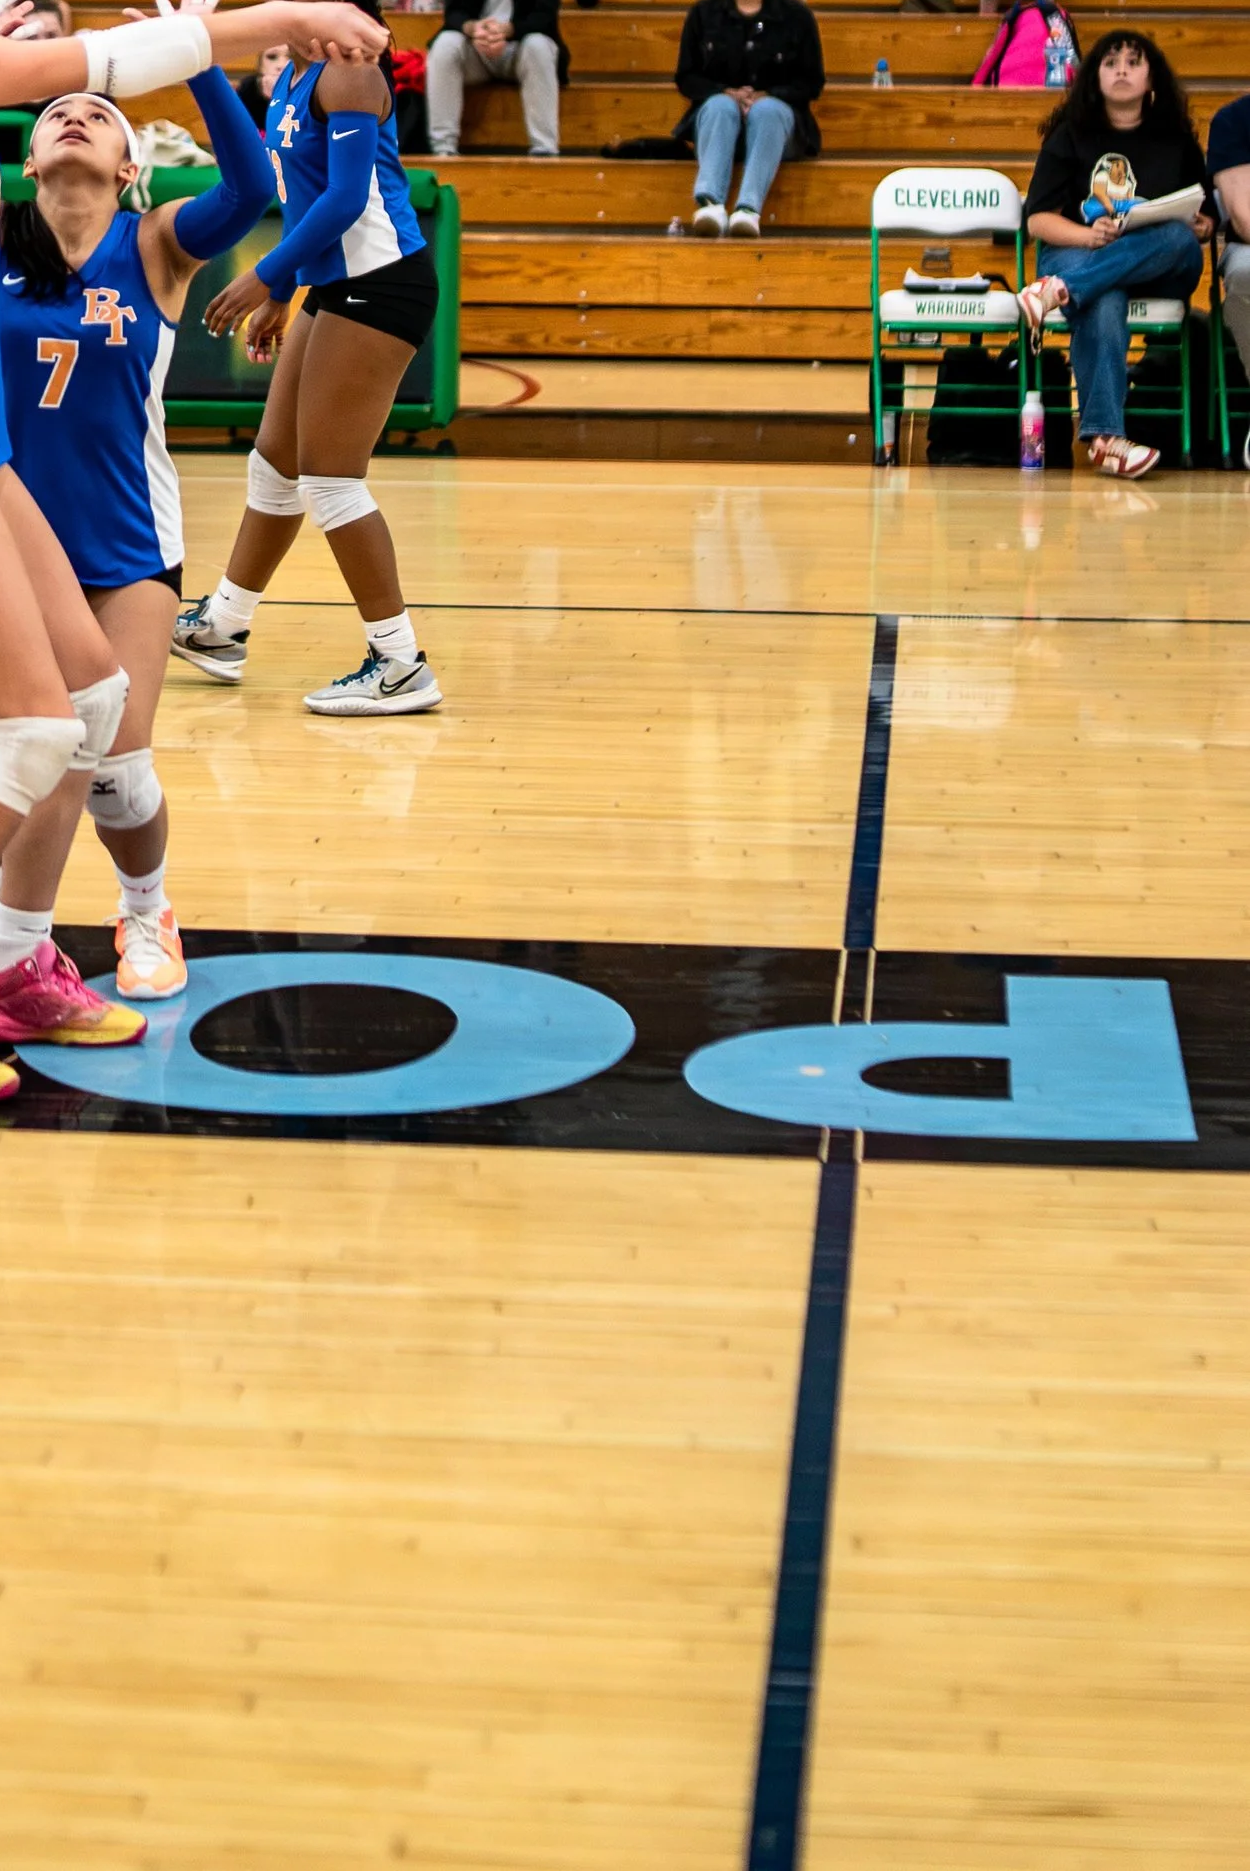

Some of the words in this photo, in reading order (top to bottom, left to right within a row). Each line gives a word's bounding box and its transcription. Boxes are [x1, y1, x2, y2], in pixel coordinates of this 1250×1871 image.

[894, 187, 1000, 209] CLEVELAND
[81, 287, 138, 346] BT
[915, 299, 986, 316] WARRIORS
[37, 337, 79, 409] 7
